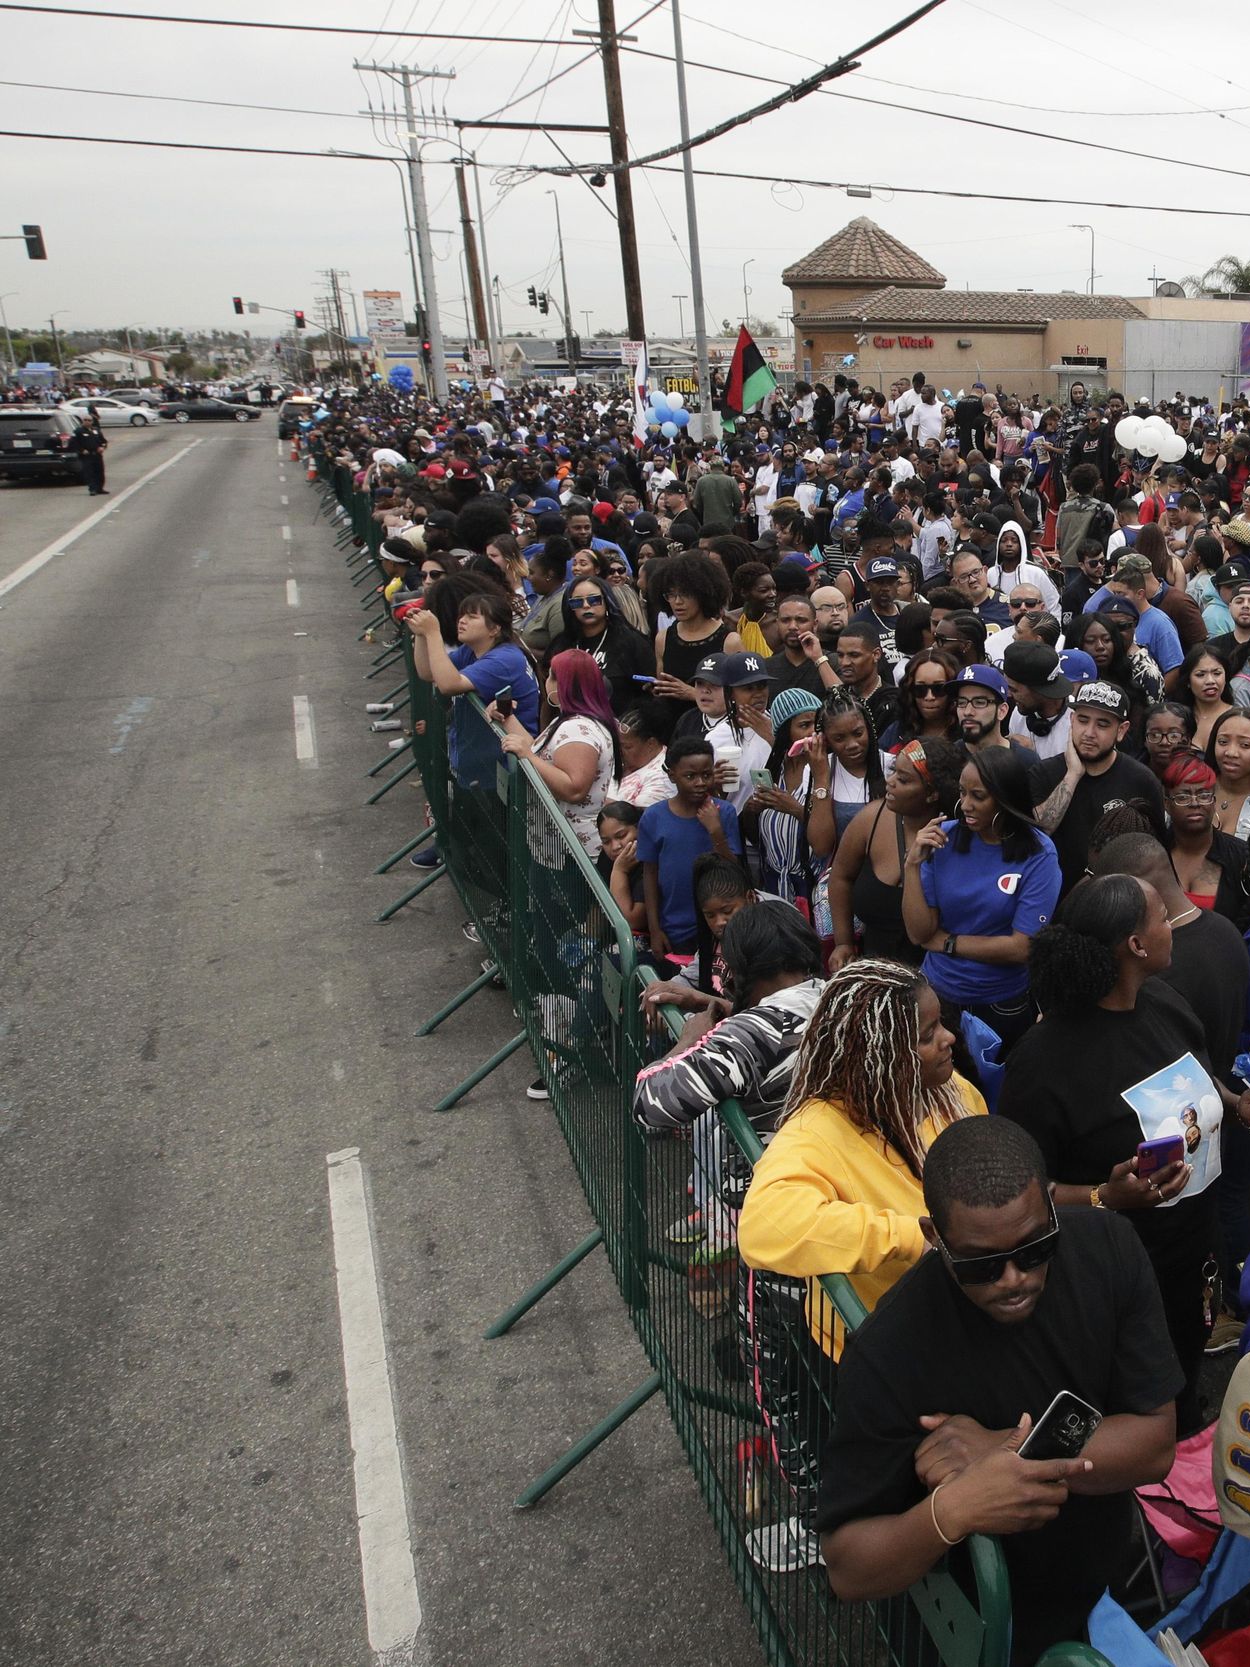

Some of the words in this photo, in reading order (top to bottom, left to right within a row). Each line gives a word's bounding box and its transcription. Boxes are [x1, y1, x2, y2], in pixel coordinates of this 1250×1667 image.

[873, 335, 896, 349] Car
[898, 335, 935, 349] Wash
[1076, 345, 1089, 355] Exit
[744, 657, 760, 671] NY
[963, 665, 975, 681] LA
